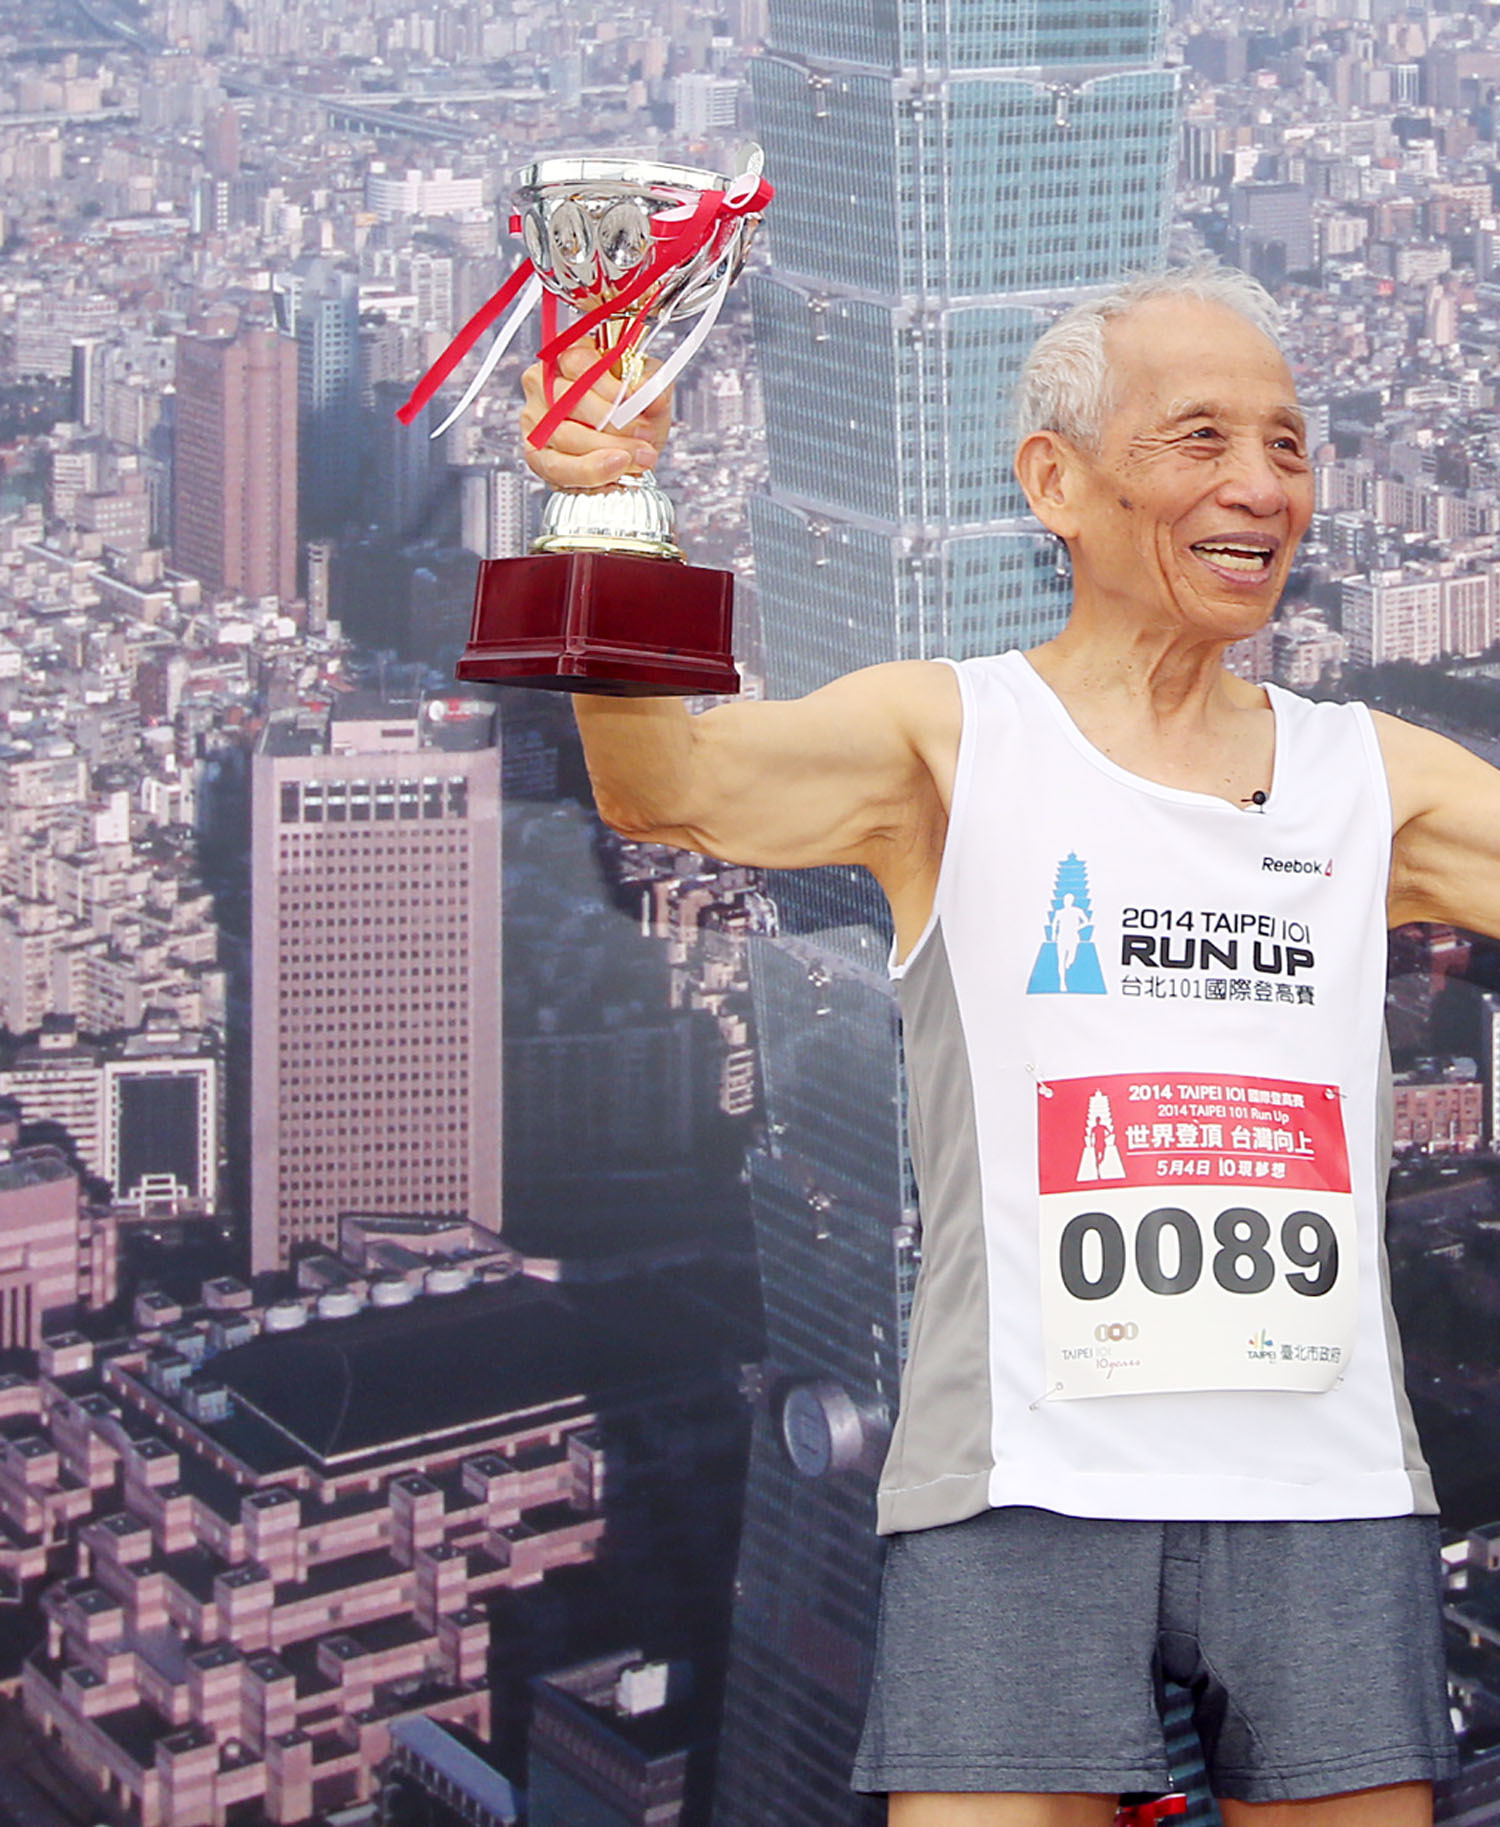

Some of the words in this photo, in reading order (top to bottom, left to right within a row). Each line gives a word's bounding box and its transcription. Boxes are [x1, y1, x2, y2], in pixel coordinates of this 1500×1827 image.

[1262, 857, 1322, 874] Reebok
[1122, 908, 1194, 931] 2014
[1201, 912, 1275, 937] TAIPEI
[1121, 934, 1237, 970] RUN
[1253, 941, 1315, 976] UP
[1121, 975, 1315, 1005] 台北101國際登高賽
[1129, 1085, 1172, 1100] 2014
[1177, 1085, 1221, 1100] TAIPEI
[1158, 1105, 1187, 1117] 2014
[1189, 1105, 1226, 1117] TAIPEI
[1229, 1107, 1248, 1119] 101
[1251, 1109, 1272, 1121] Run
[1274, 1112, 1290, 1125] Up
[1125, 1123, 1222, 1149] 世界登頂
[1231, 1127, 1314, 1154] 台灣向上
[1157, 1160, 1209, 1176] 5月4日
[1060, 1207, 1339, 1301] 0089
[1062, 1348, 1093, 1360] TAIPEI
[1248, 1350, 1276, 1359] TAIPEI
